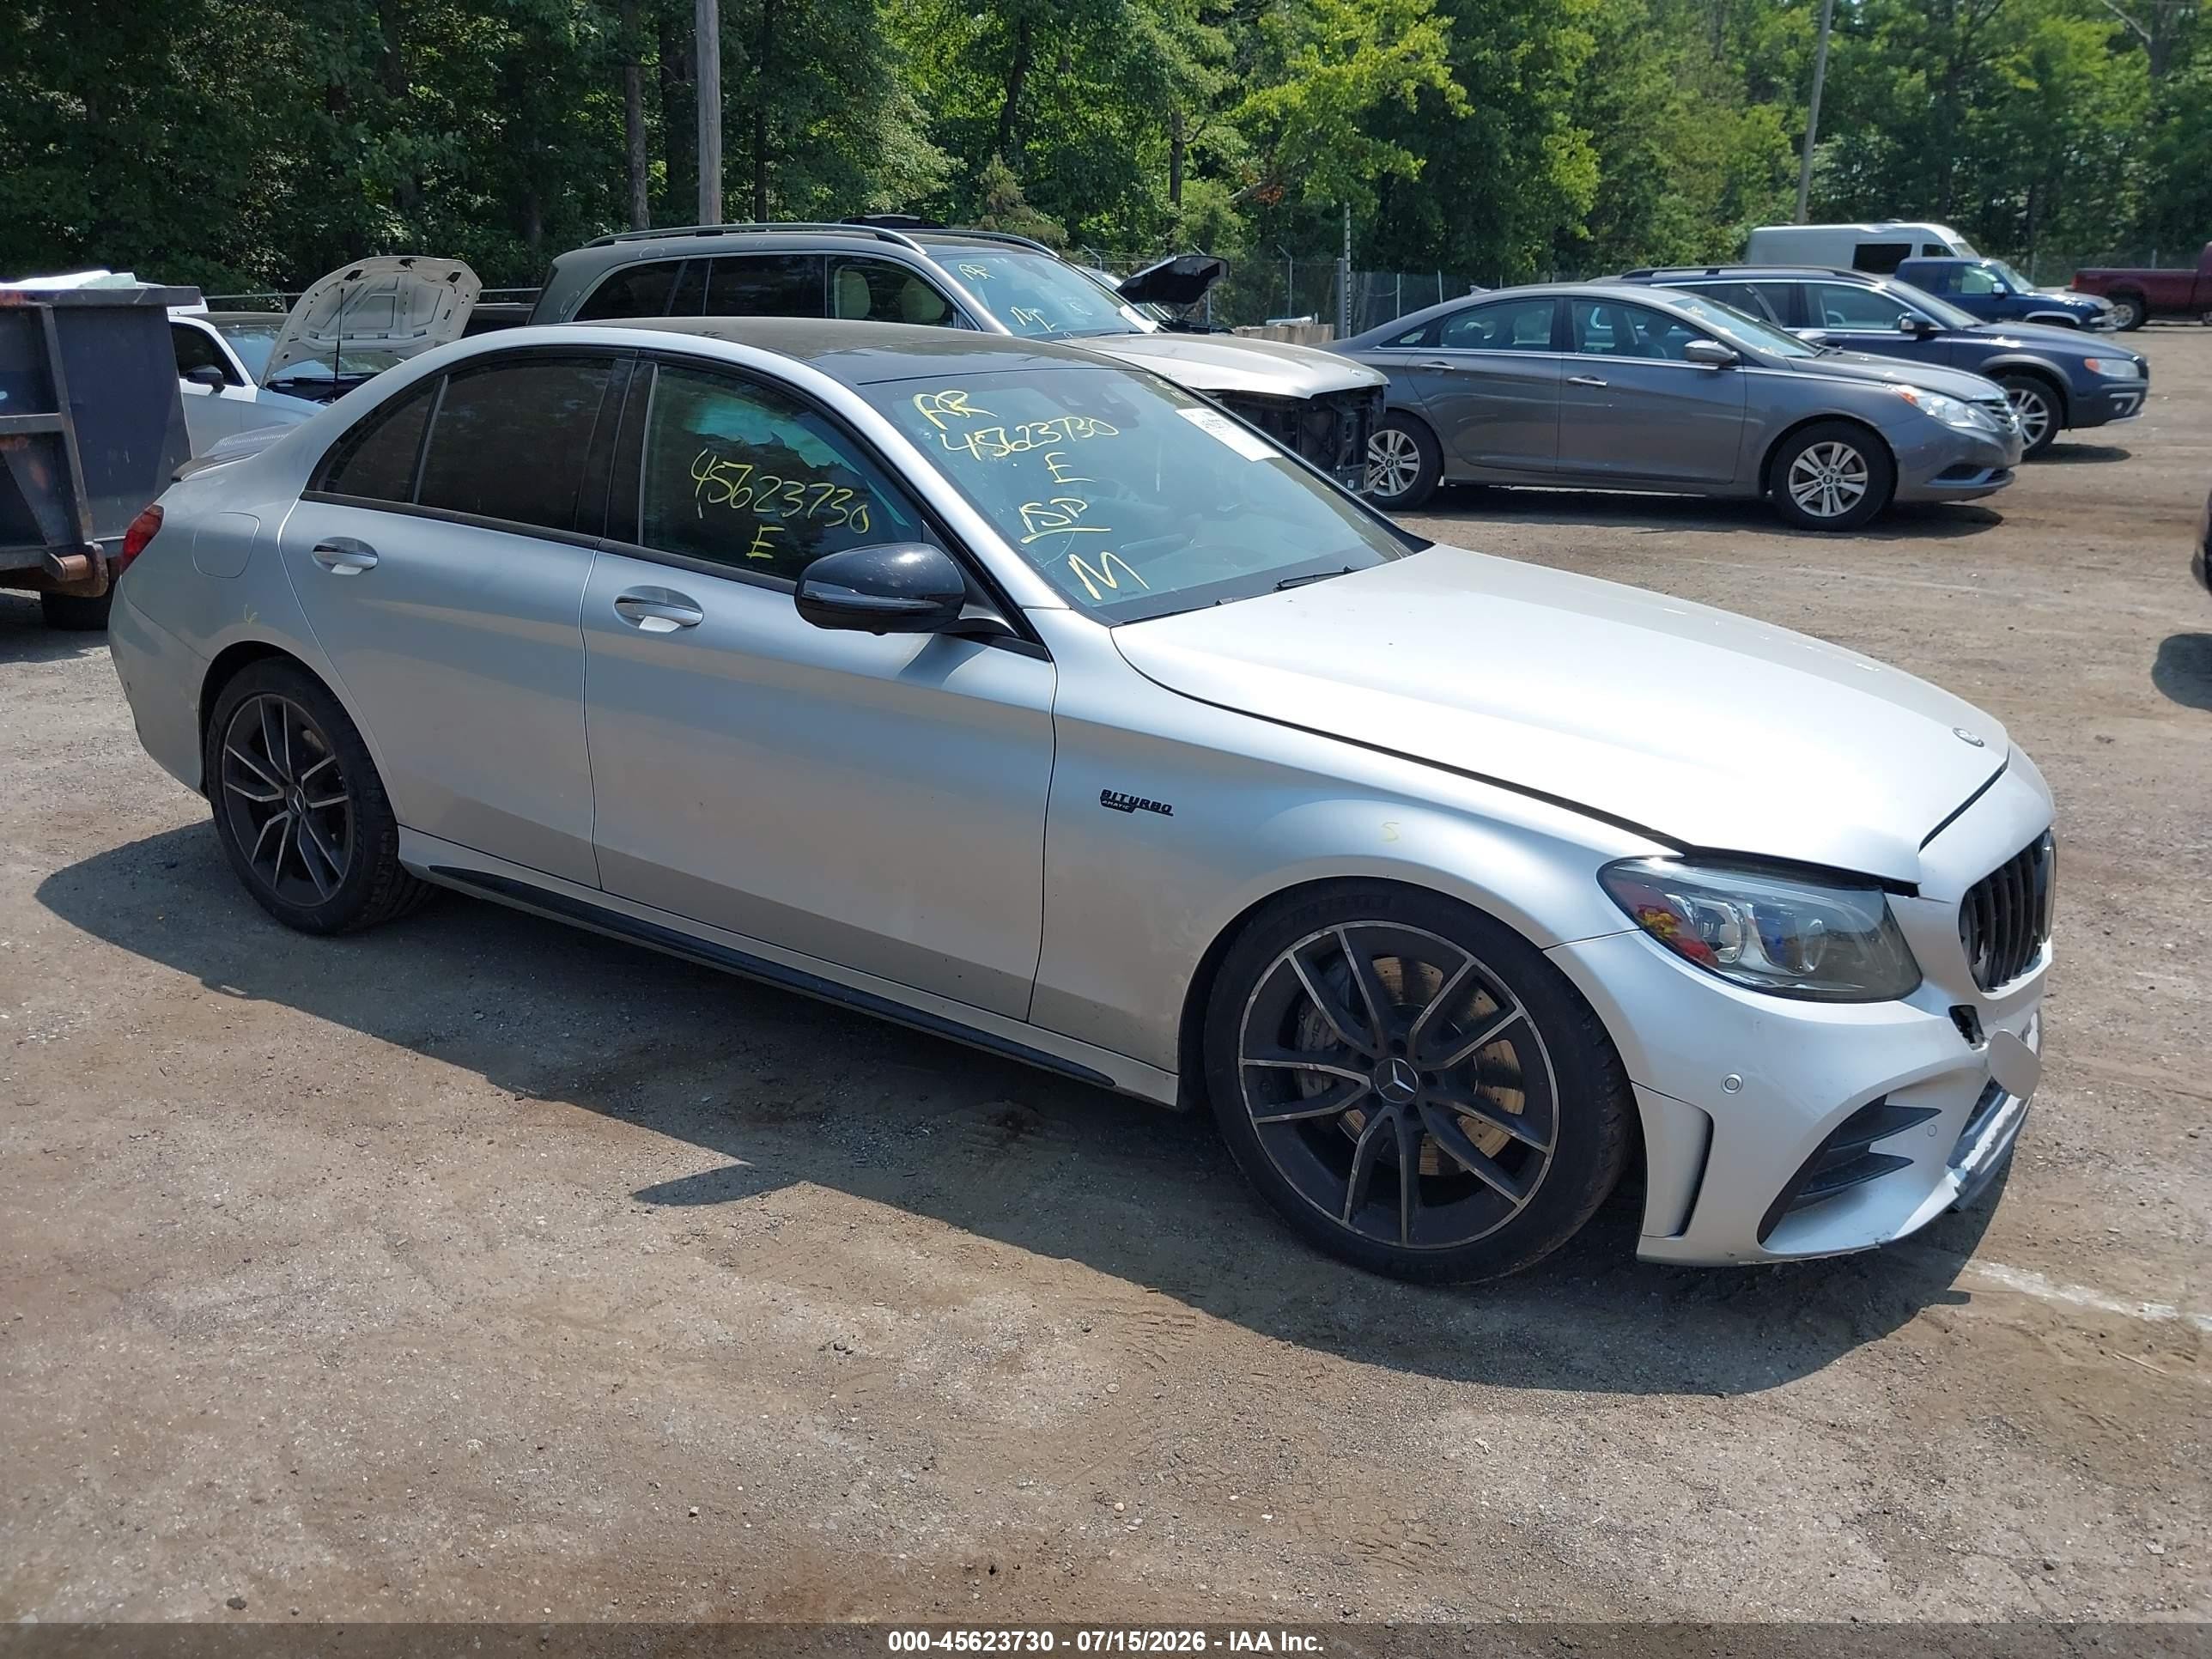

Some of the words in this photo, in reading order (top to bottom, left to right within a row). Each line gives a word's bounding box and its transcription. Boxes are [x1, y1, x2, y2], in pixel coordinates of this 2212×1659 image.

[940, 416, 1119, 460] 45623730
[1044, 452, 1096, 483] E
[690, 447, 870, 534] 45623730
[745, 524, 786, 559] E
[1067, 551, 1151, 600] M
[1100, 788, 1174, 816] BITURBO
